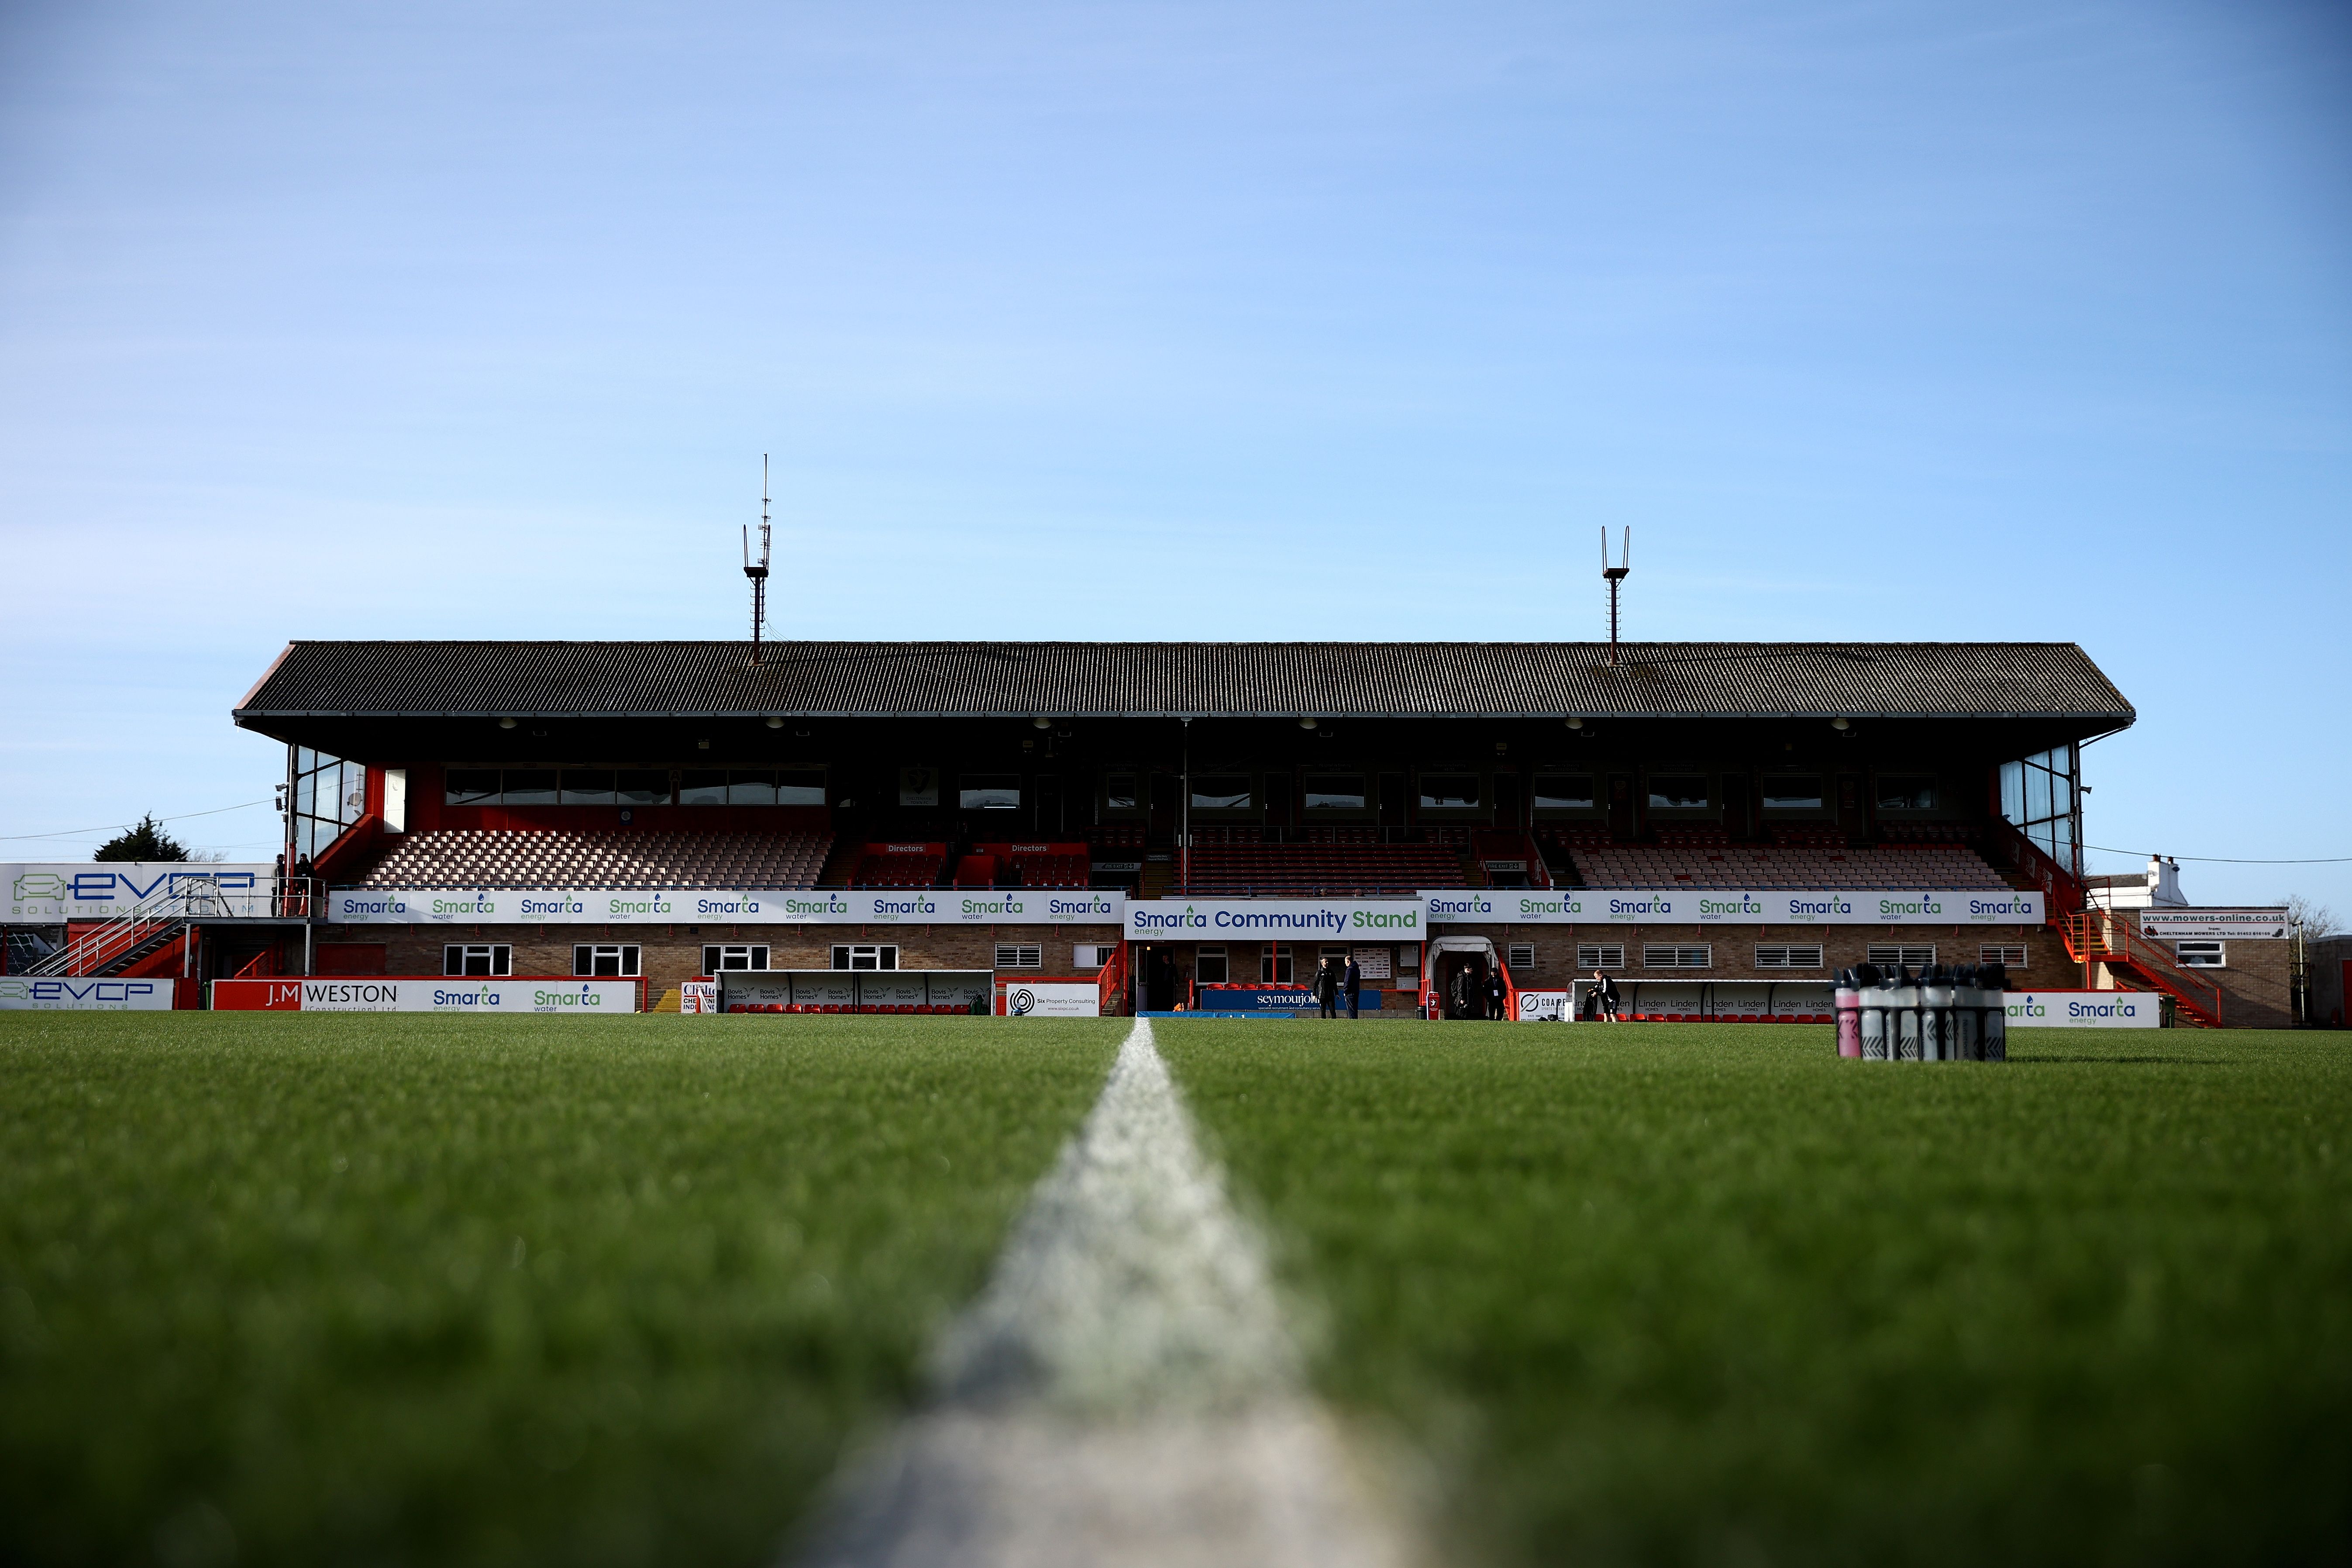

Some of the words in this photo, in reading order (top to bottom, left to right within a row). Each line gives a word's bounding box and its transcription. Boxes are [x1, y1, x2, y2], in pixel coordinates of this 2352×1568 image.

[344, 899, 405, 913] Smarta
[433, 899, 494, 913] Smarta
[521, 899, 582, 913] Smarta
[610, 899, 671, 913] Smarta
[698, 899, 759, 913] Smarta
[786, 899, 847, 913] Smarta
[874, 899, 935, 913] Smarta
[962, 899, 1023, 913] Smarta
[1050, 899, 1111, 913] Smarta
[1430, 899, 1491, 913] Smarta
[1520, 899, 1581, 913] Smarta
[1610, 899, 1671, 913] Smarta
[1700, 899, 1761, 913] Smarta
[1790, 900, 1851, 914] Smarta
[1880, 900, 1941, 914] Smarta
[1970, 900, 2031, 914] Smarta
[1134, 910, 1206, 927] Smarta
[1215, 910, 1347, 934] Community
[1353, 910, 1416, 928] Stand
[266, 985, 299, 1006] J.M
[306, 985, 396, 1003] WESTON
[434, 990, 500, 1005] Smarta
[534, 990, 600, 1006] Smarta
[2004, 1005, 2045, 1017] arta
[2069, 1002, 2135, 1017] Smarta
